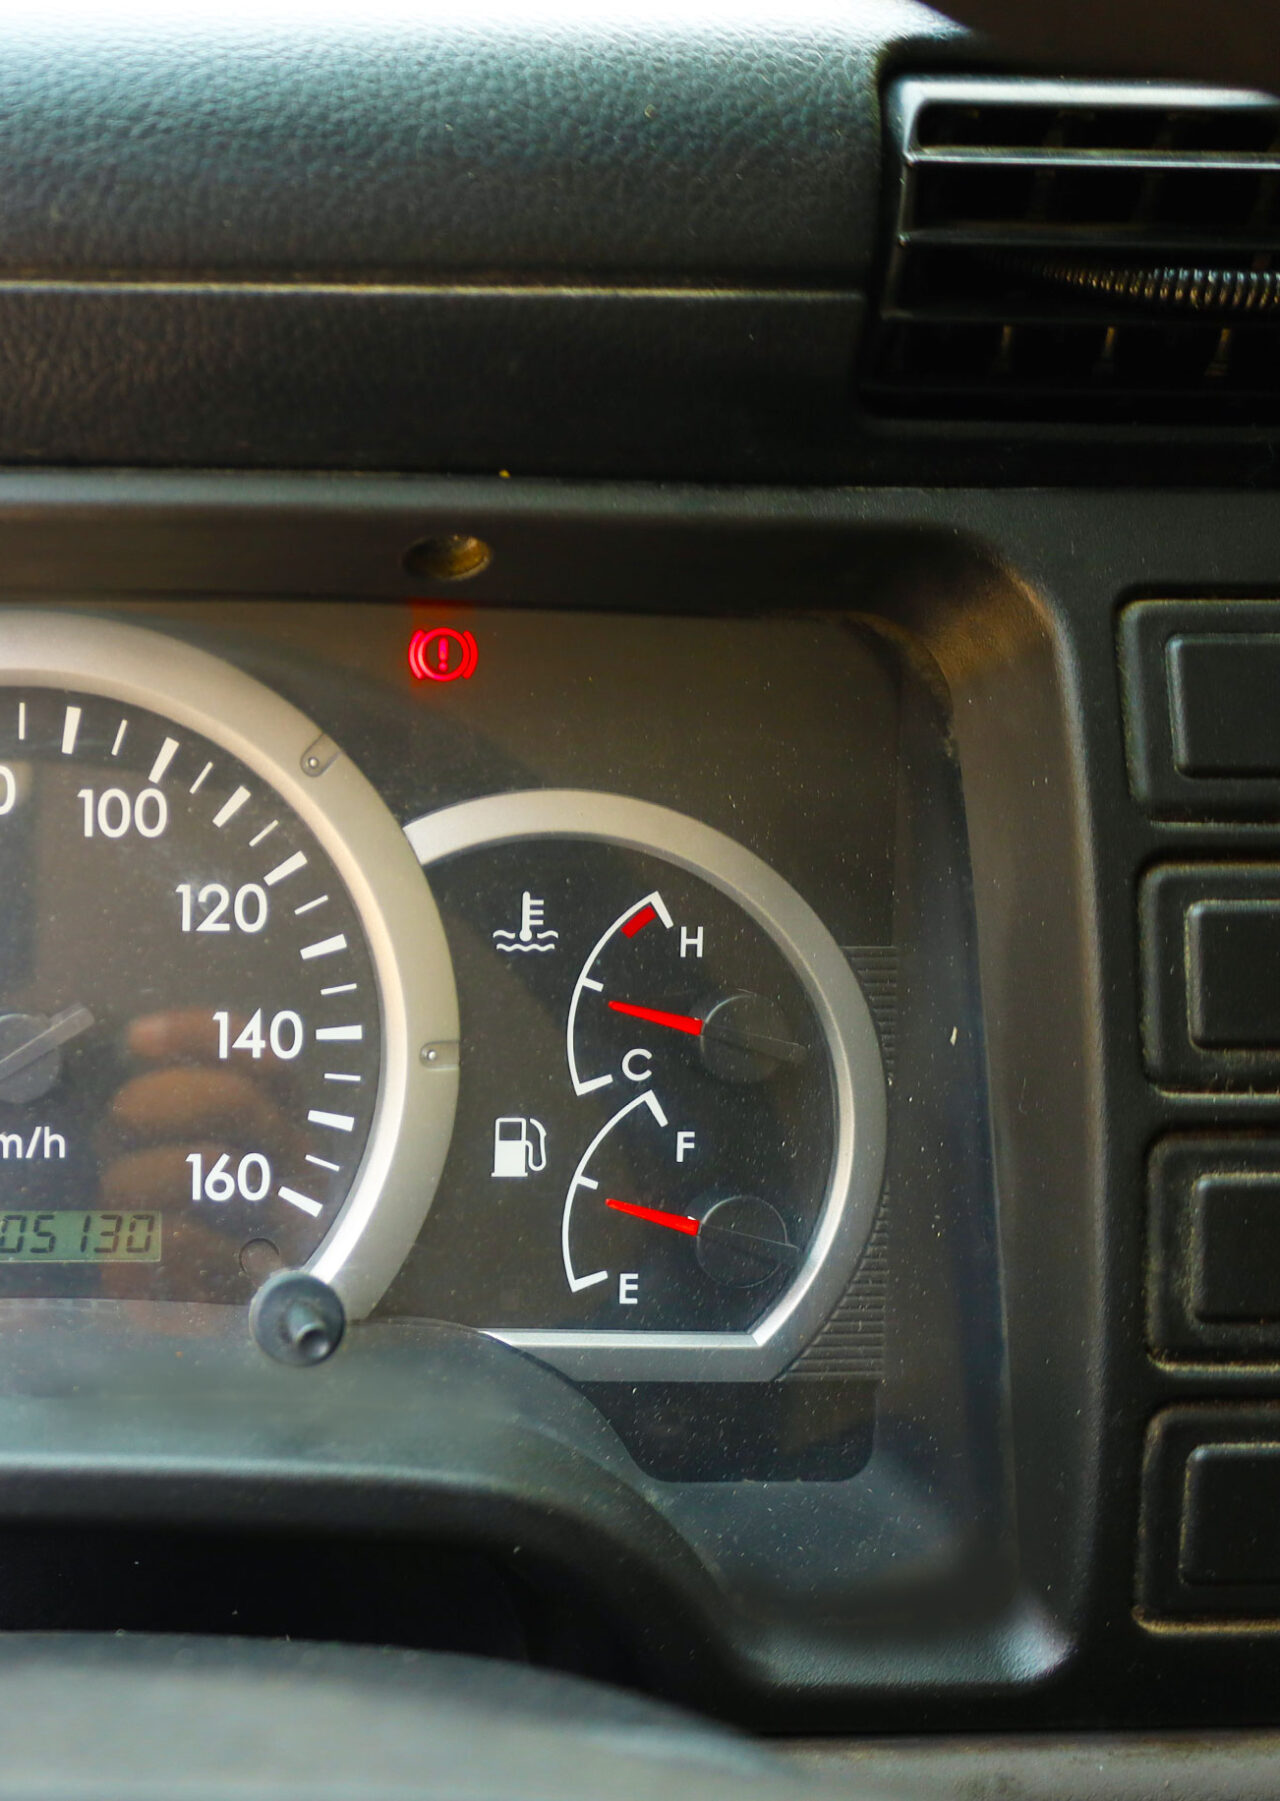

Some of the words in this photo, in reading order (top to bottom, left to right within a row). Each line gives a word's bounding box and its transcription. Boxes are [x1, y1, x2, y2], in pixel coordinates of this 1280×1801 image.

[78, 788, 168, 838] 100
[175, 884, 268, 933] 120
[680, 926, 704, 958] H
[212, 1010, 303, 1060] 140
[621, 1048, 653, 1082] C
[676, 1131, 696, 1163] F
[185, 1153, 271, 1201] 160
[619, 1273, 639, 1305] E
